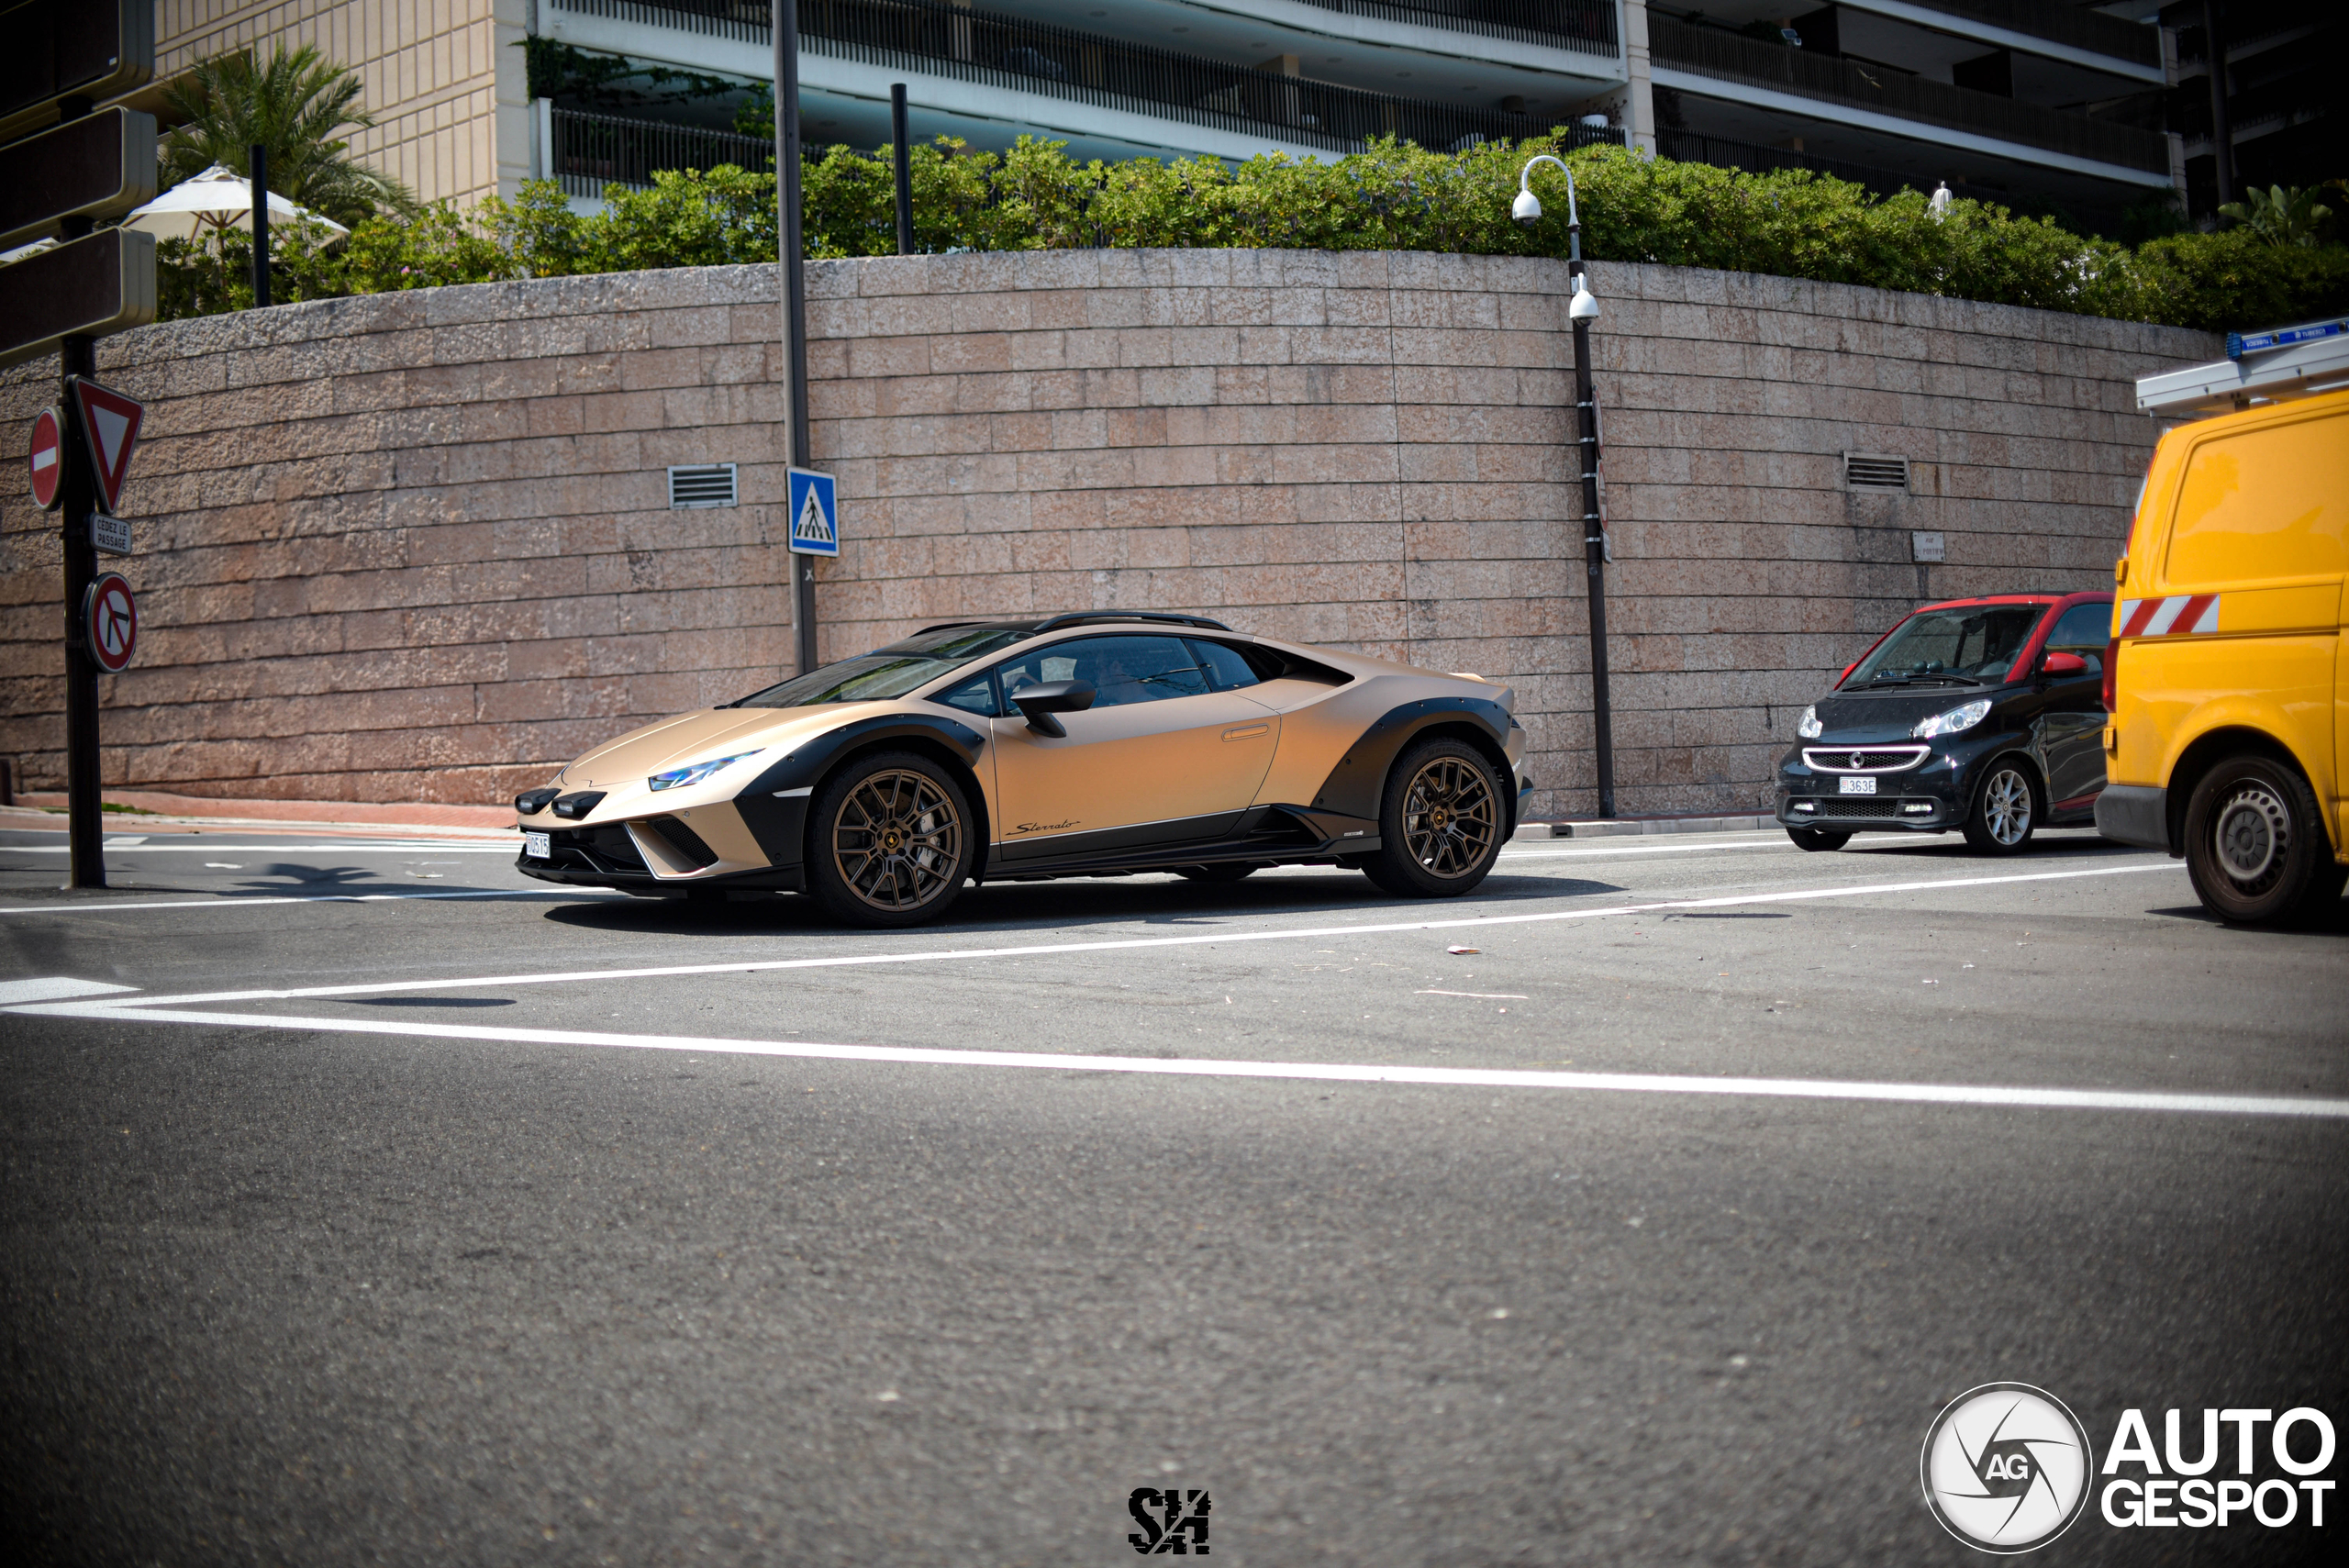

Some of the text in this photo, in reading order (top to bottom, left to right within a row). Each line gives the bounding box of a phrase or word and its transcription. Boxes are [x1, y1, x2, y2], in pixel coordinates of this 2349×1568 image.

[97, 518, 127, 536] CÉDEZ LE
[97, 533, 126, 550] PASSAGE
[1849, 780, 1875, 792] 363E
[1005, 819, 1081, 836] Sterrato
